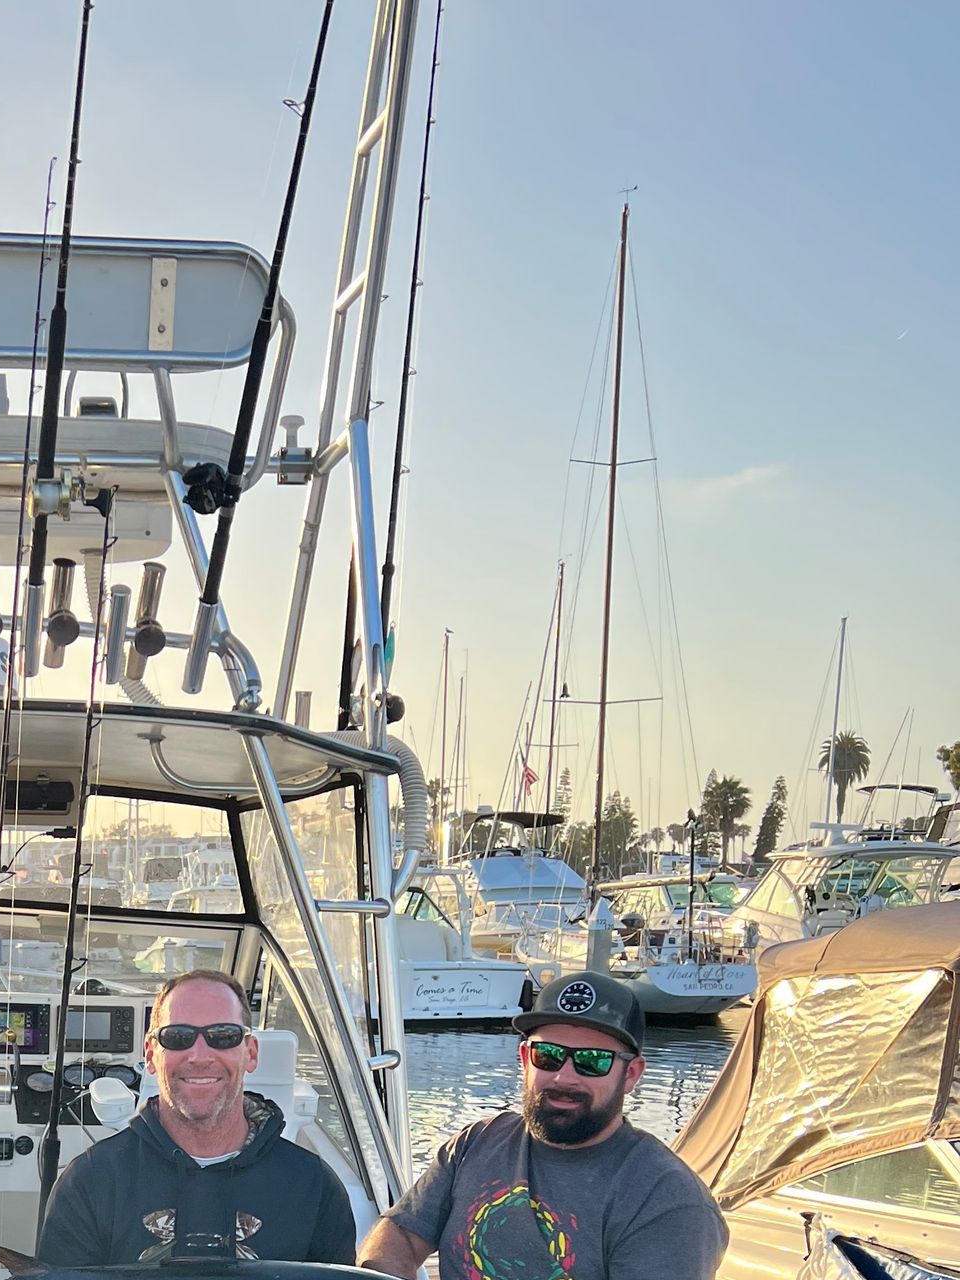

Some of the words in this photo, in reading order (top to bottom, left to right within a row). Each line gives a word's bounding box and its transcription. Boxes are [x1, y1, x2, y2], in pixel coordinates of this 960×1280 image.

[416, 984, 444, 997] Comes
[460, 981, 483, 994] Time
[683, 983, 698, 991] SAN
